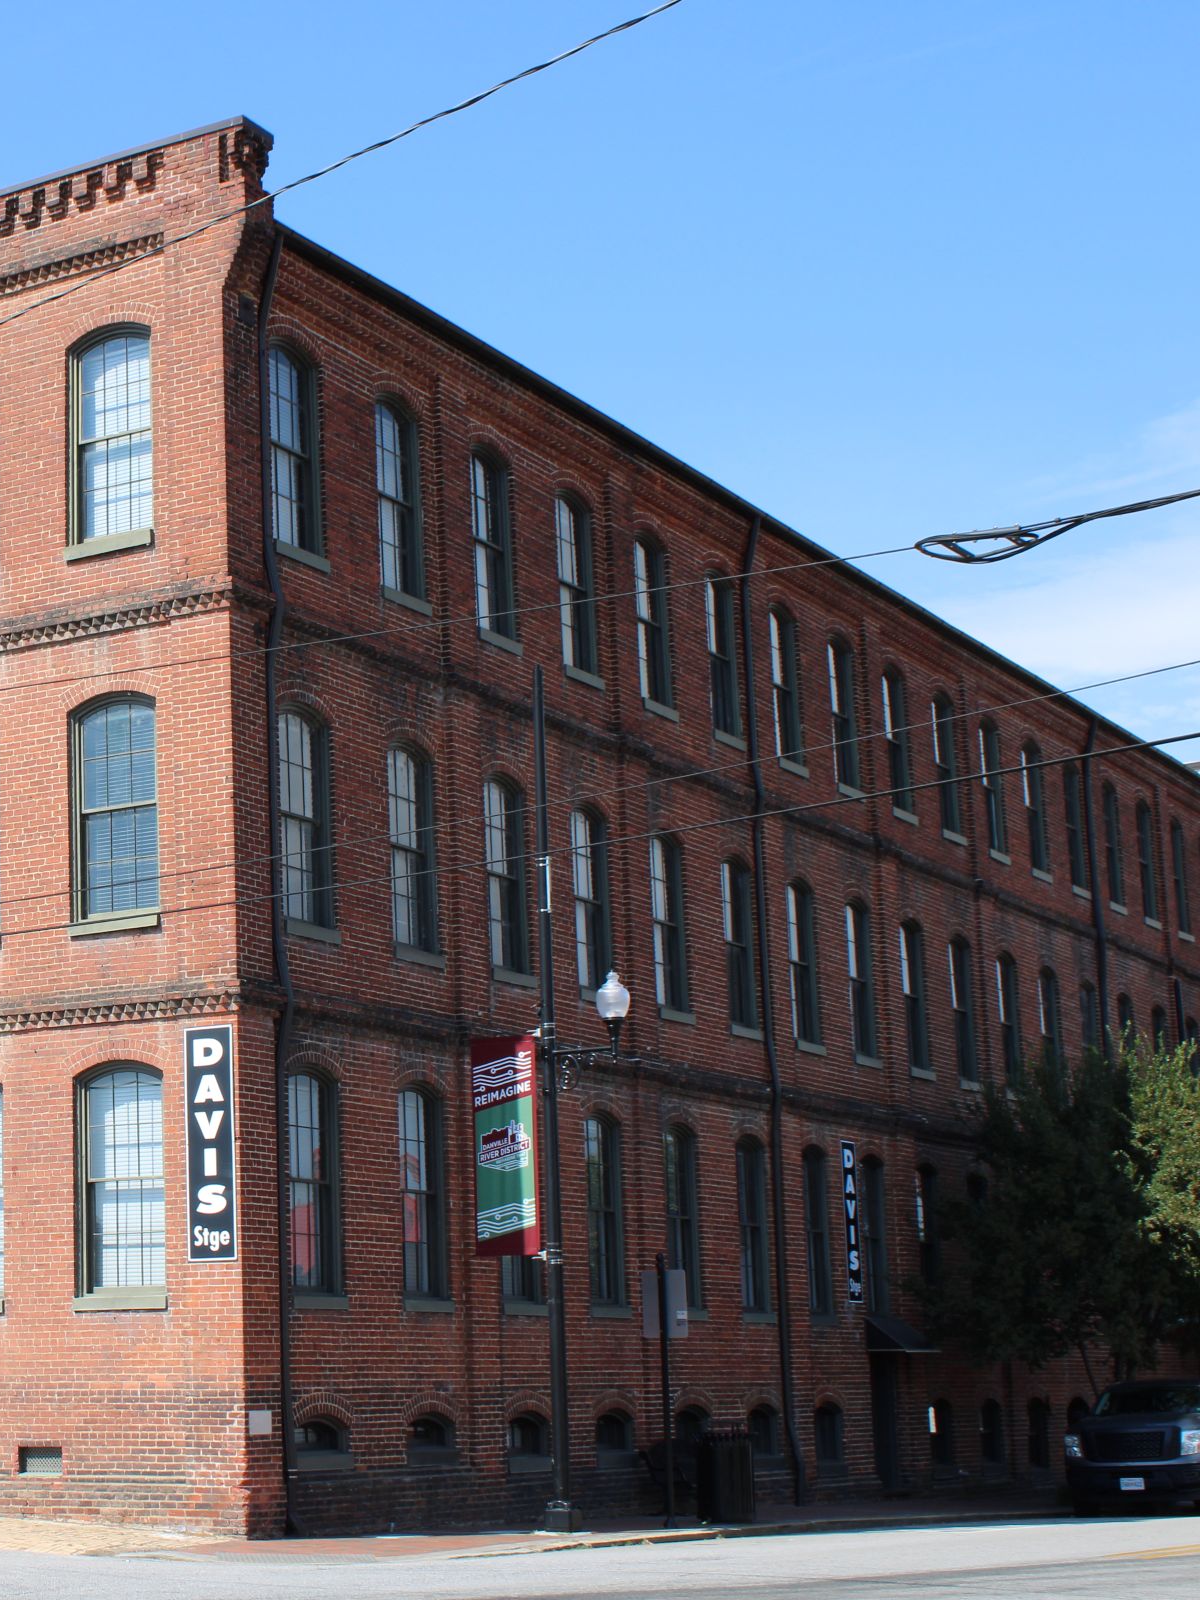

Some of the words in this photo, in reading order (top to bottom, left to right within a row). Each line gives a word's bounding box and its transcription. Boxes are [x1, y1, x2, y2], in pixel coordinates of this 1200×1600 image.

[474, 1080, 531, 1108] REIMAGINE
[193, 1038, 227, 1214] DAVIS
[480, 1150, 500, 1162] RIVER
[500, 1140, 529, 1156] DISTRICT
[482, 1137, 508, 1151] DANVILLE
[843, 1148, 859, 1271] DAVIS
[193, 1225, 231, 1252] Stge
